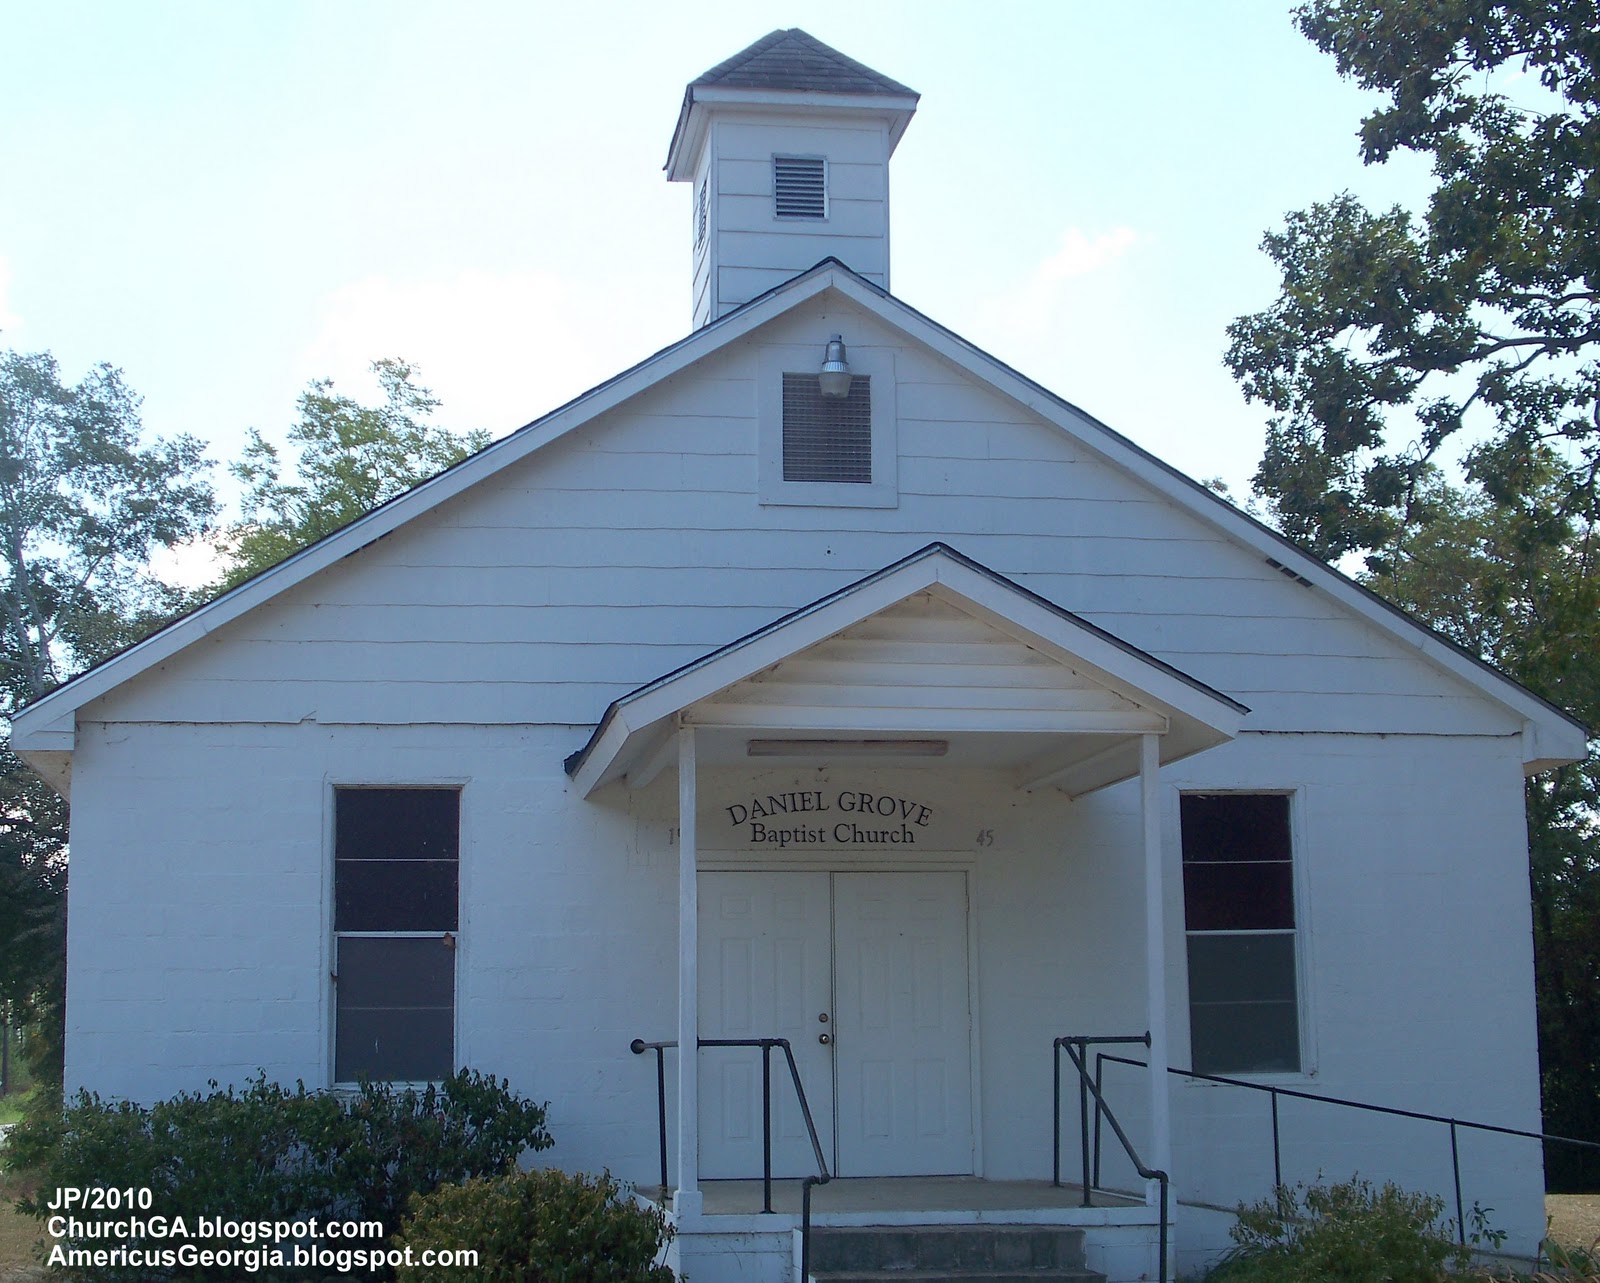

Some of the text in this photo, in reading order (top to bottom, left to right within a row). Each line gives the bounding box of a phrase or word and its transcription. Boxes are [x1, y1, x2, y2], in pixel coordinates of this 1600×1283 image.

[726, 791, 933, 827] DANIEL GROVE
[750, 822, 915, 847] Baptist Church
[976, 829, 994, 847] 45
